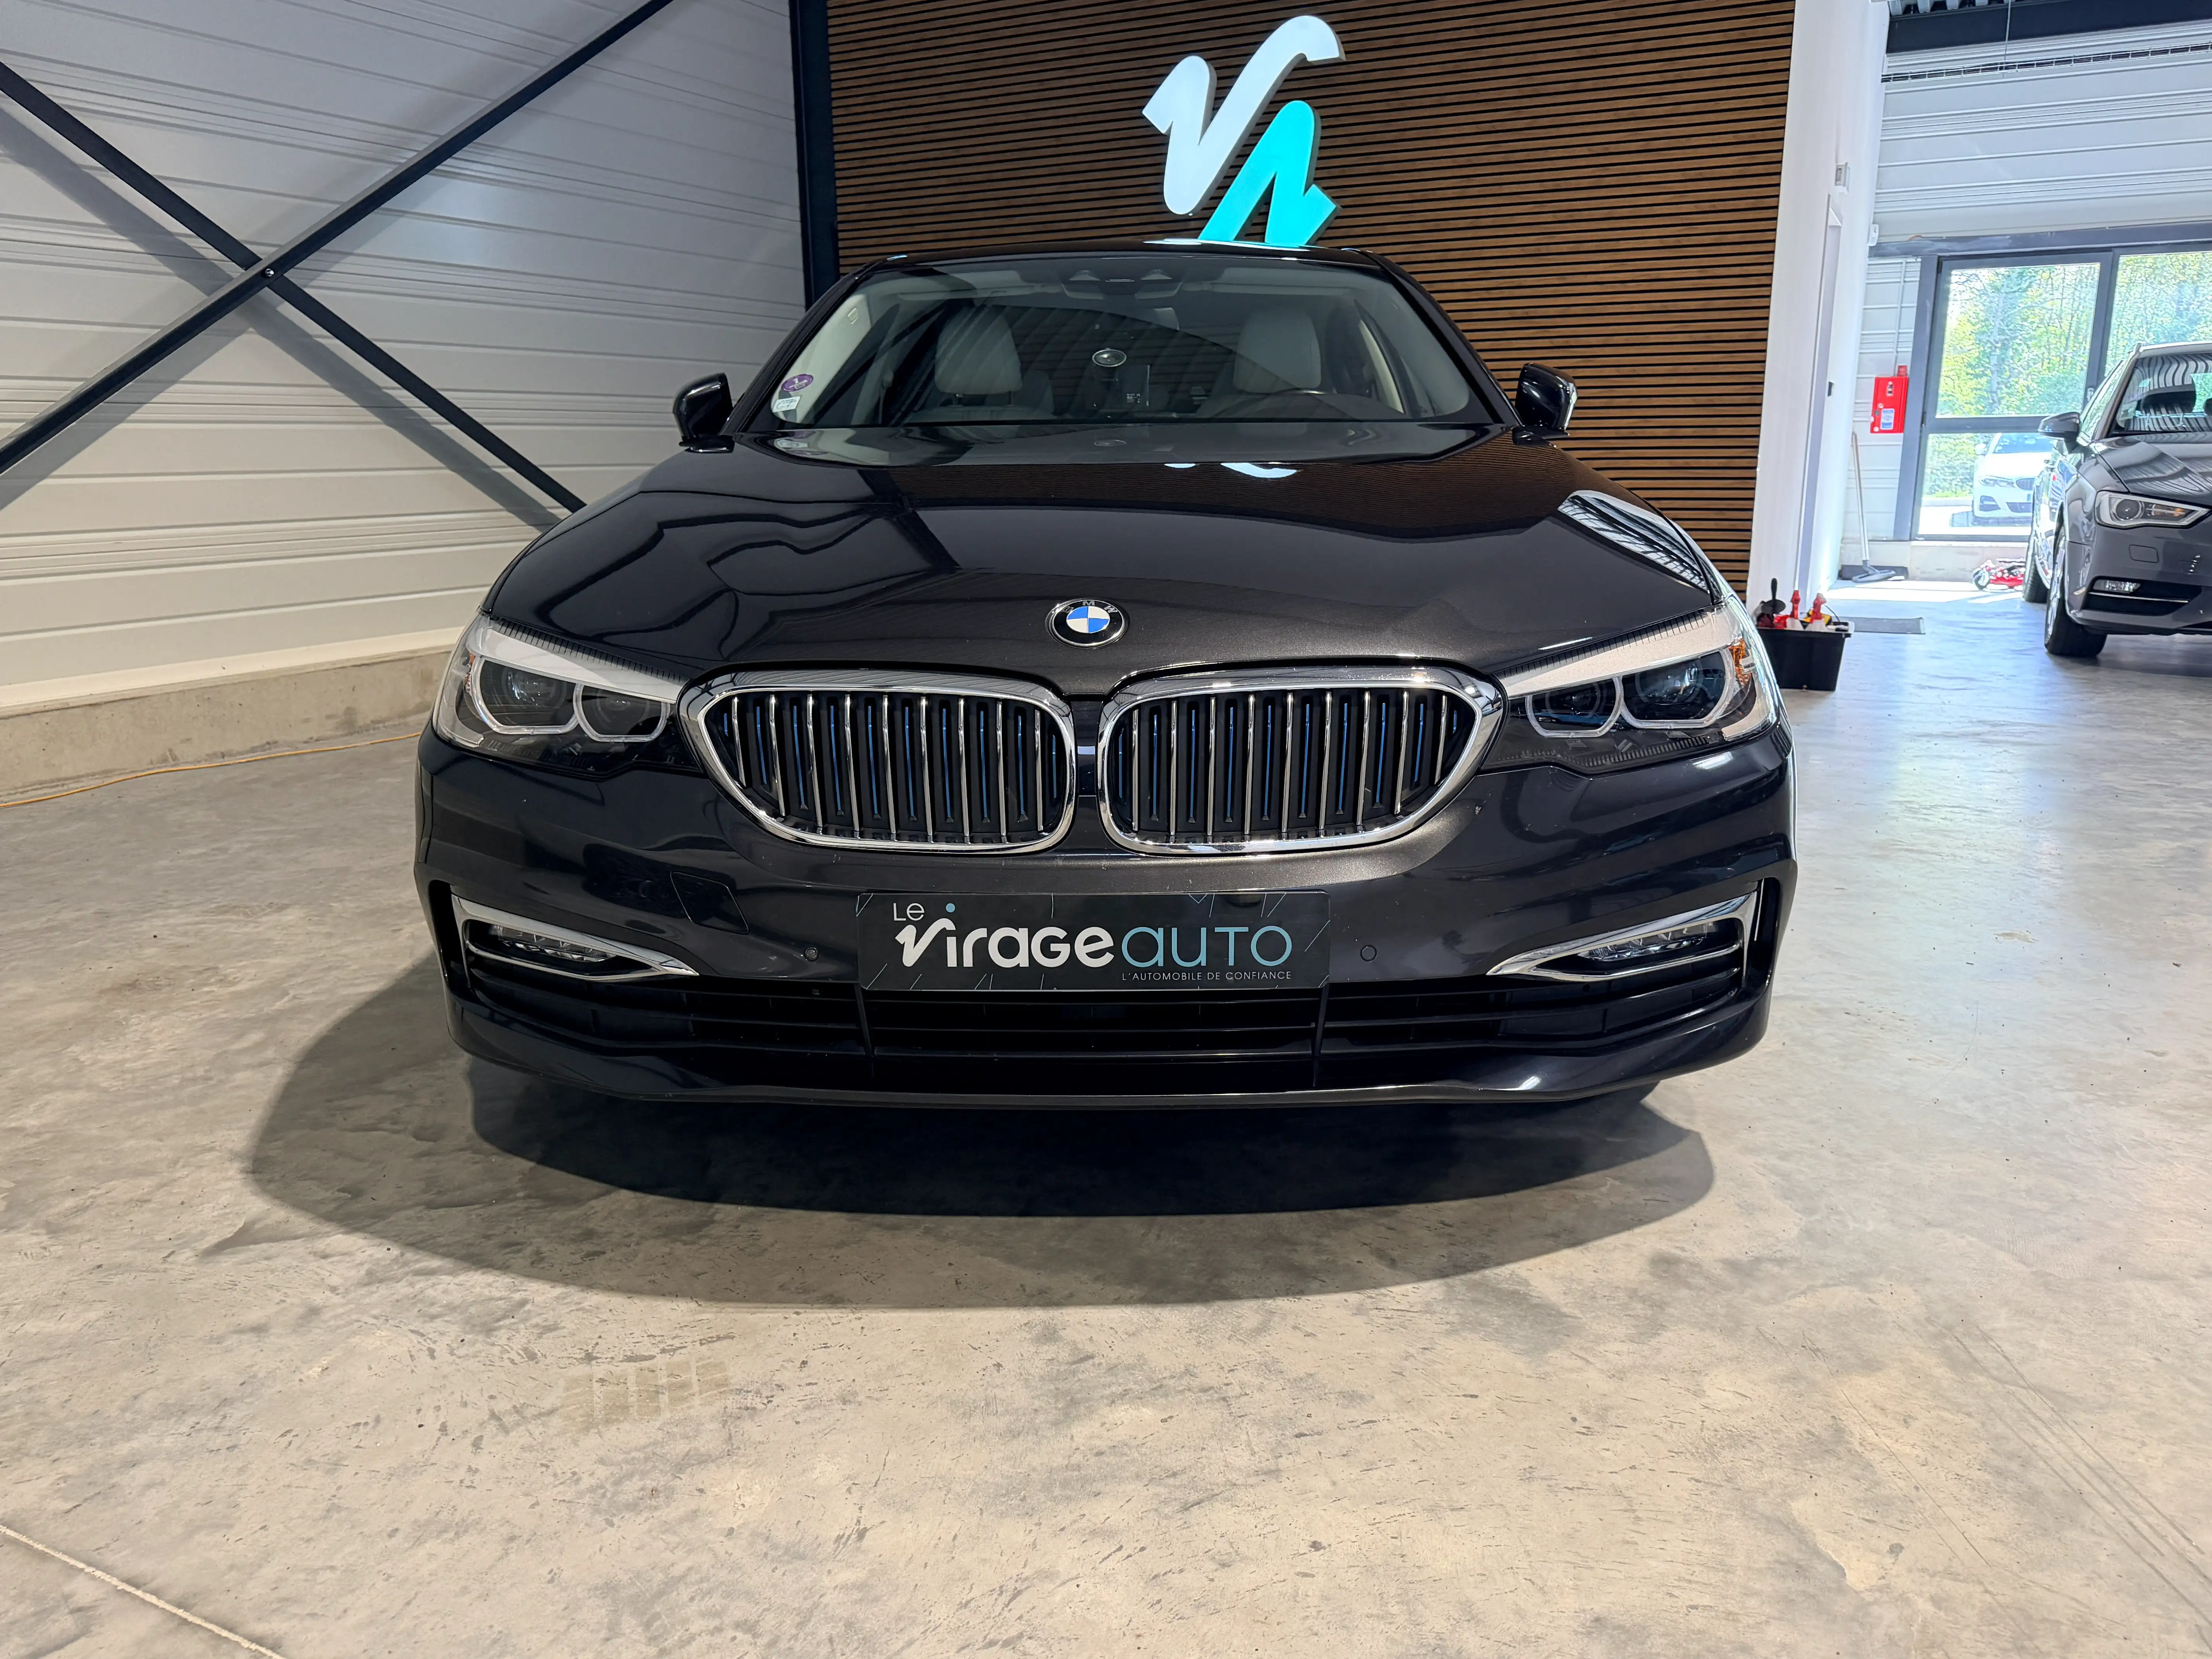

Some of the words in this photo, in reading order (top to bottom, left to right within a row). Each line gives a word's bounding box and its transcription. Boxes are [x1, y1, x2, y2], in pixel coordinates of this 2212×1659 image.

[1061, 600, 1118, 614] BMW
[893, 903, 925, 921] Le
[1122, 972, 1202, 981] L'AUTOMOBILE
[1225, 971, 1291, 980] CONFIANCE
